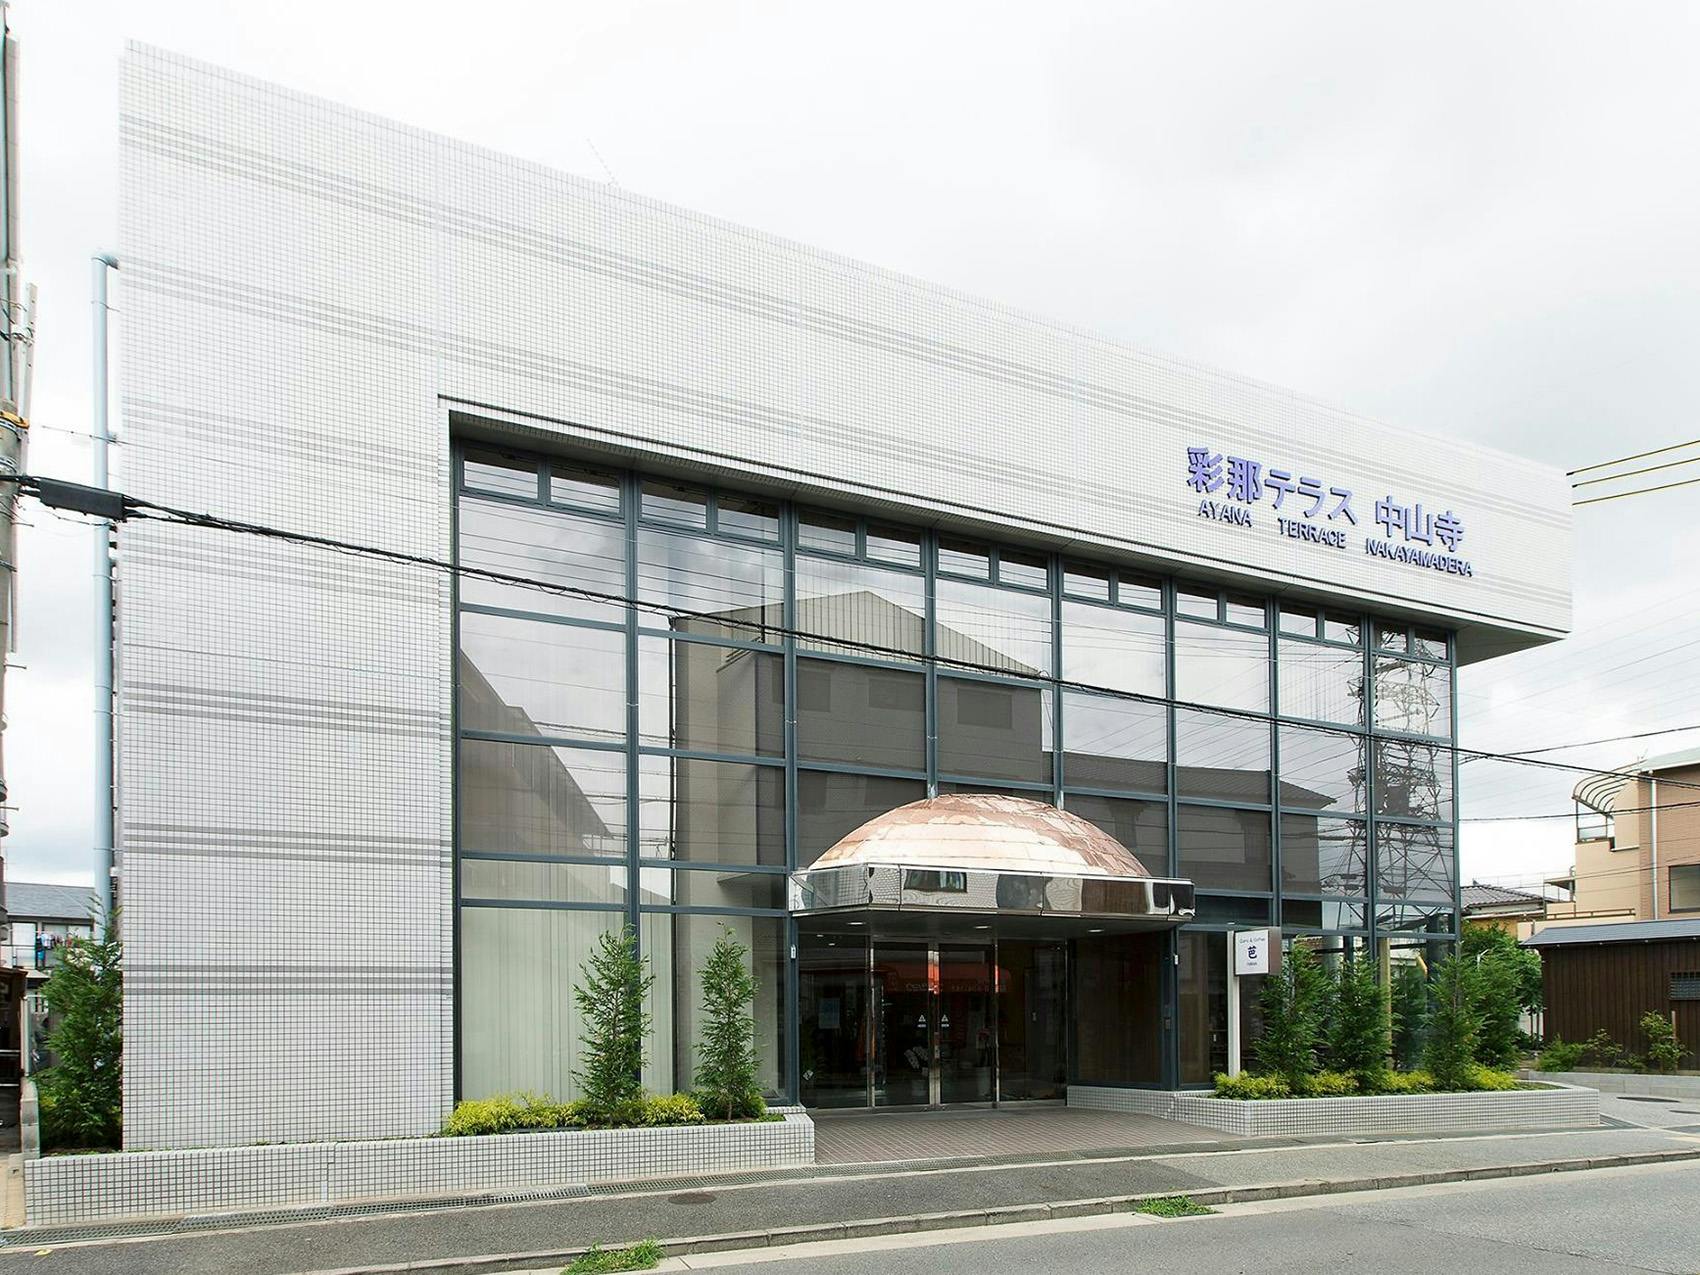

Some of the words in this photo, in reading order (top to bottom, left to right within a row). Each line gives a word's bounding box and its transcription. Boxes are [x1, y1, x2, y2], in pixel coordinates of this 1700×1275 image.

[1187, 446, 1358, 525] 彩那テラス
[1375, 495, 1465, 551] 中山寺
[1199, 499, 1252, 528] AYANA
[1278, 516, 1346, 549] TERRACE
[1365, 538, 1473, 577] NAKAYAMADERA
